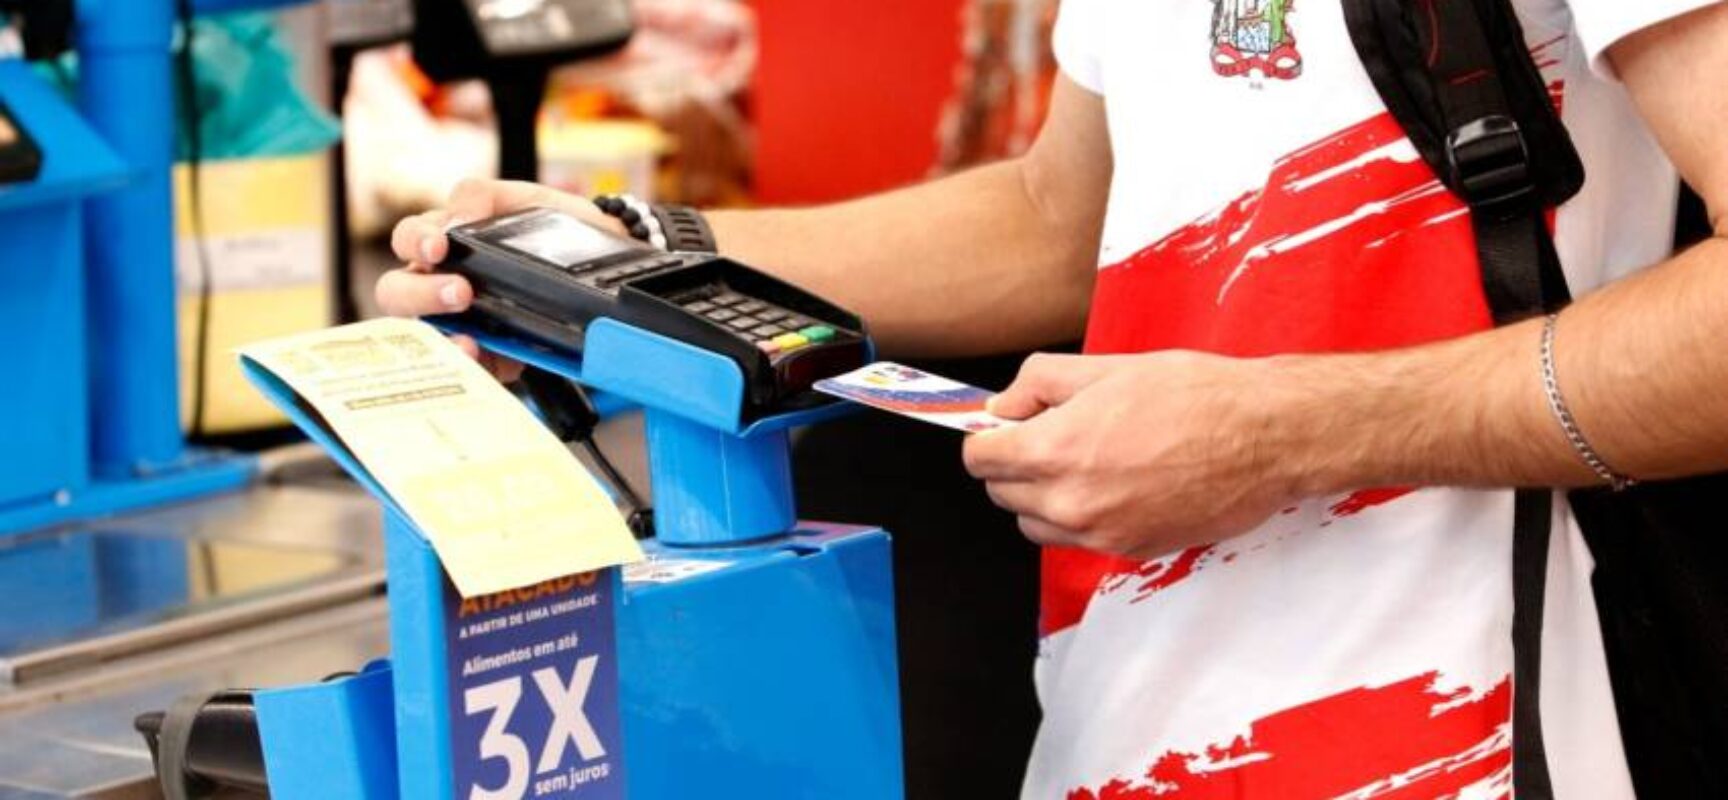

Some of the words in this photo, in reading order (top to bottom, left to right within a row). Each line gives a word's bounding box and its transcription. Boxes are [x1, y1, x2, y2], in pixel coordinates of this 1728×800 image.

[459, 627, 468, 638] A
[469, 616, 507, 635] PARTIR
[509, 612, 523, 627] DE
[526, 606, 549, 622] UMA
[551, 594, 598, 615] UNIDADE
[462, 647, 532, 676] Alimentos
[534, 641, 555, 657] em
[557, 632, 578, 652] até
[464, 655, 607, 800] 3X
[535, 774, 569, 796] sem
[569, 763, 610, 791] juros
